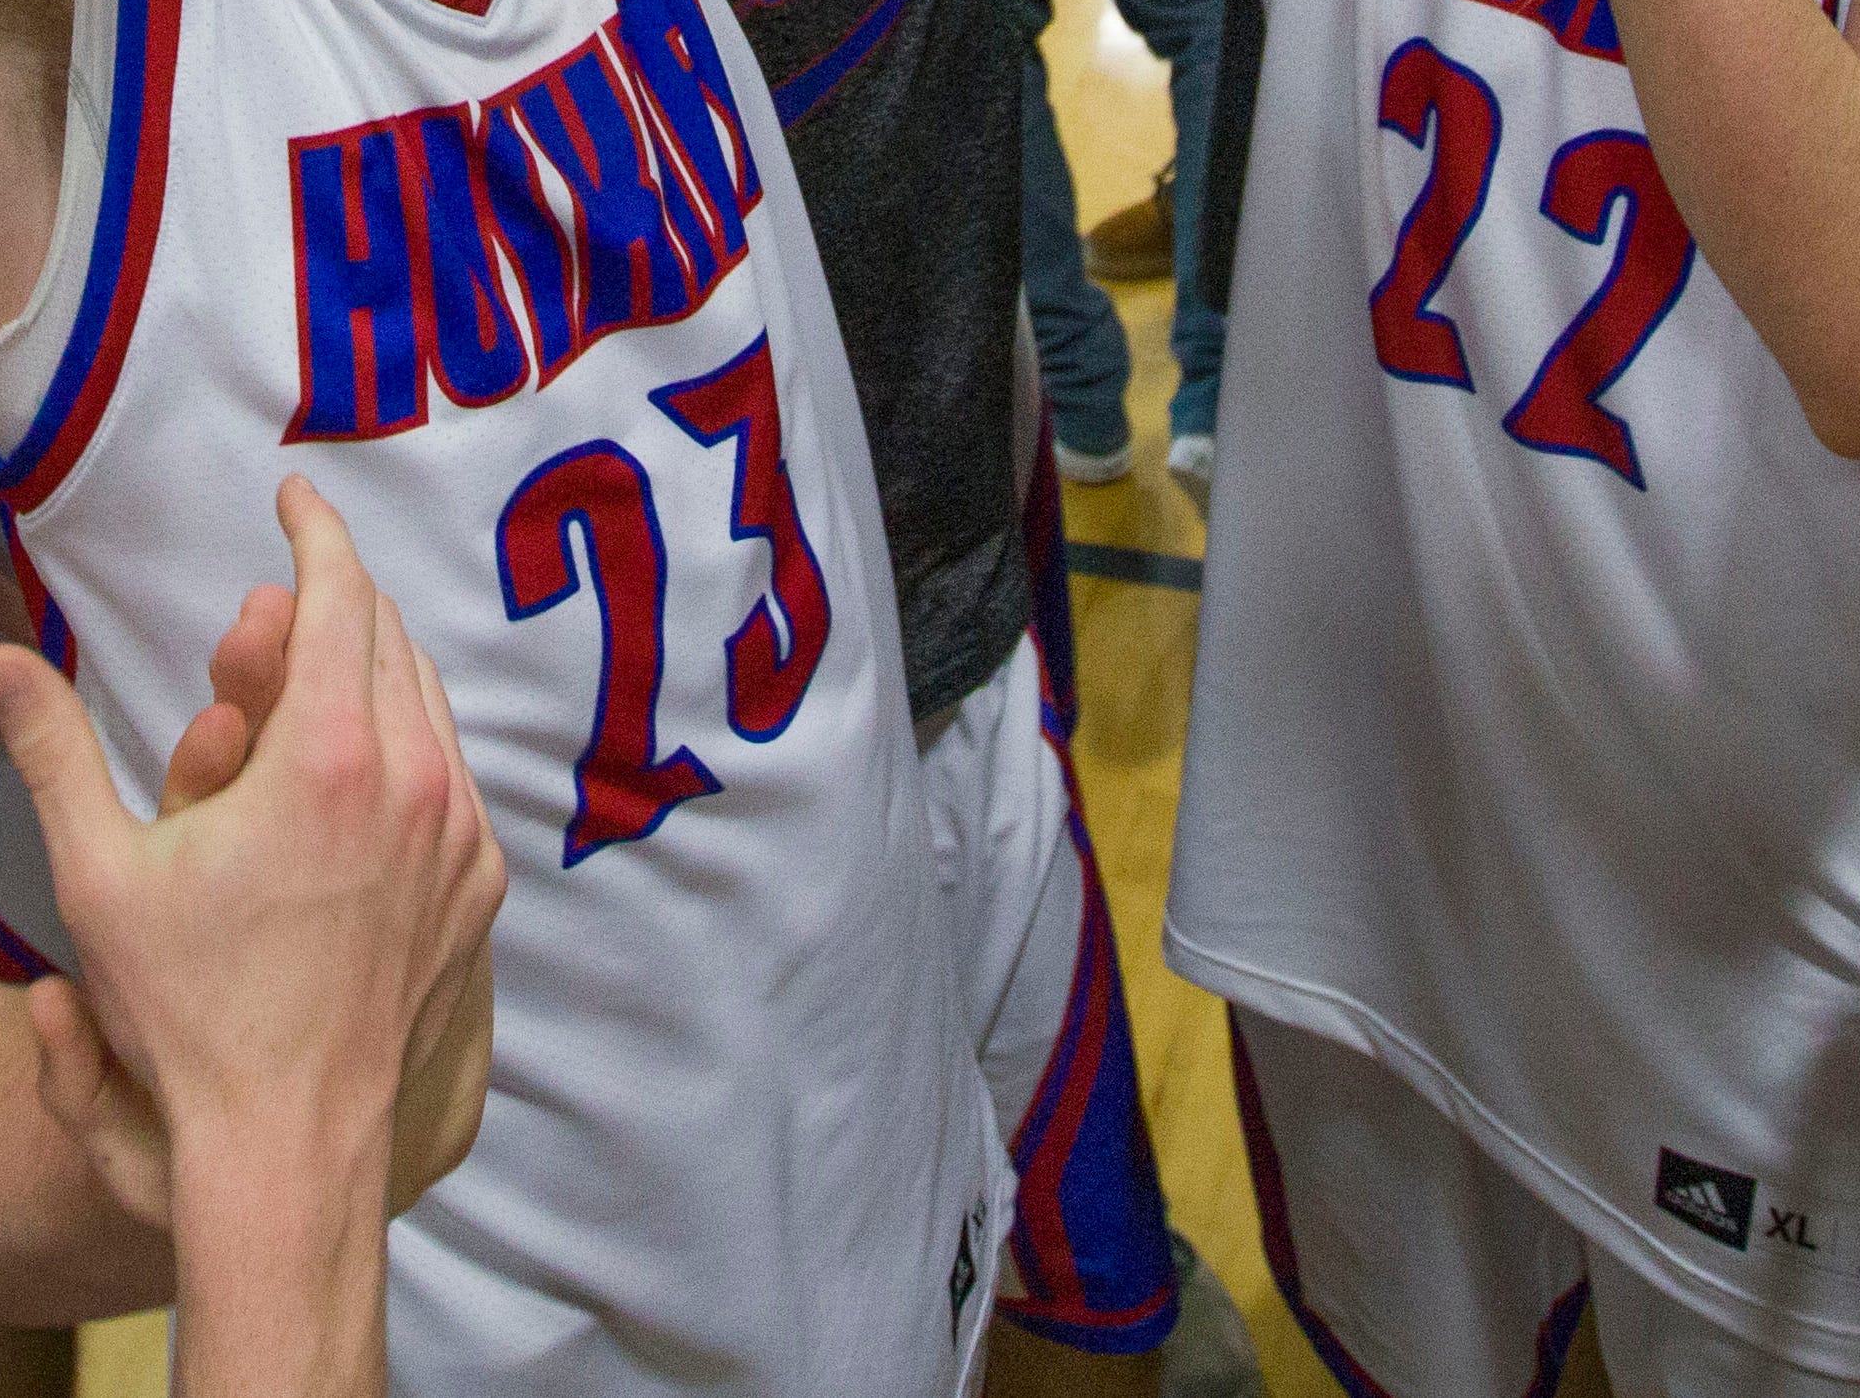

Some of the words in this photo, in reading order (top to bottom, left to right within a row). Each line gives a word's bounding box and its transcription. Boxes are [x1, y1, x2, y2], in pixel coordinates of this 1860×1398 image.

[1369, 37, 1697, 492] 22
[496, 326, 832, 868] 23
[1764, 1206, 1818, 1252] XL
